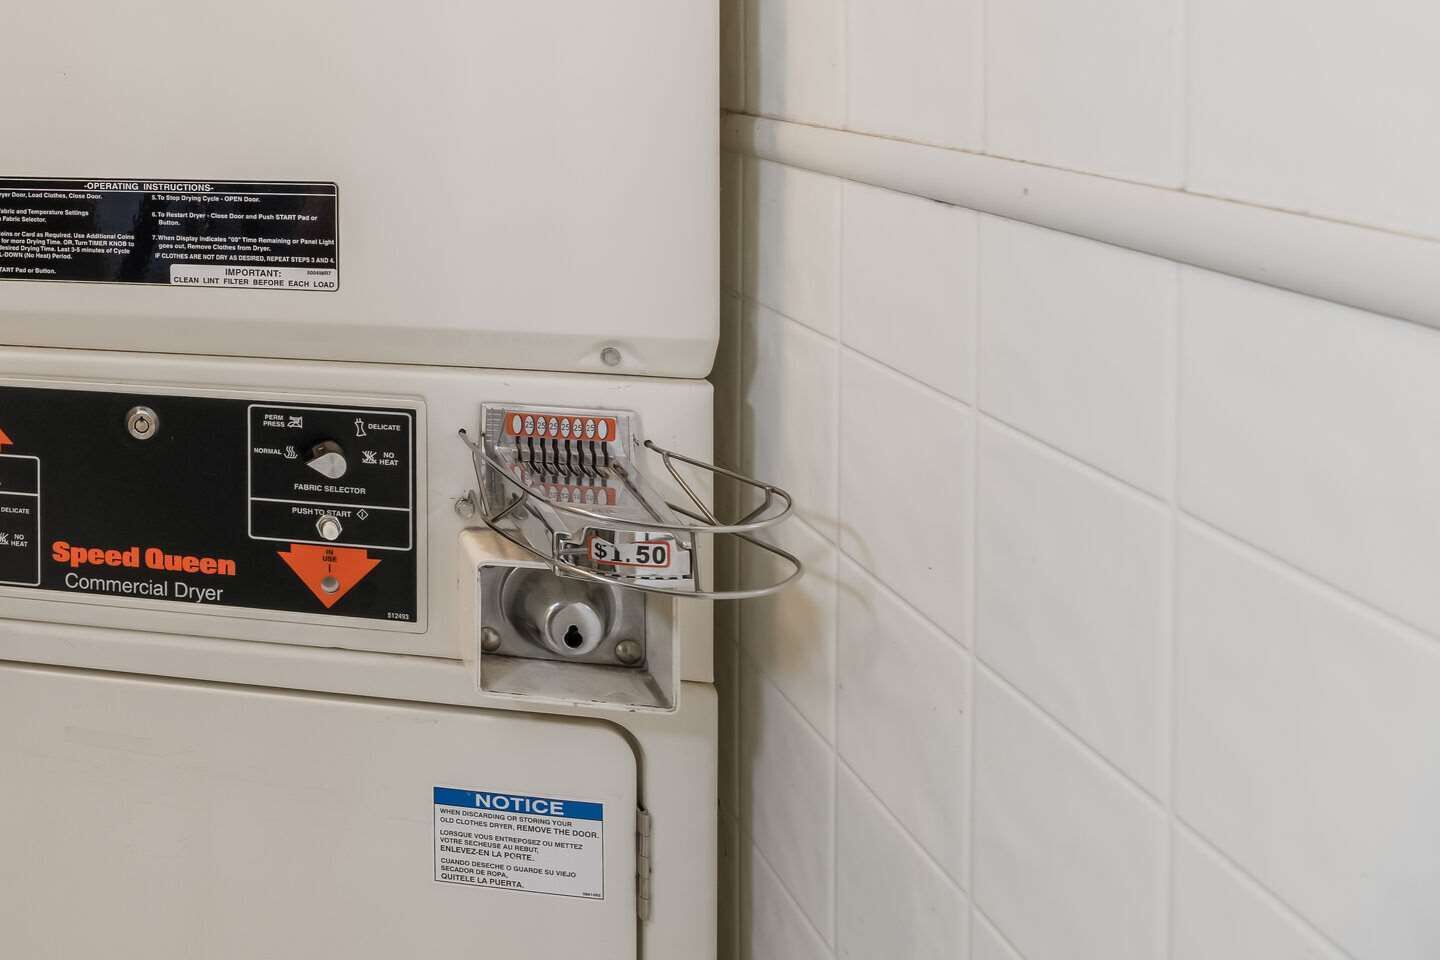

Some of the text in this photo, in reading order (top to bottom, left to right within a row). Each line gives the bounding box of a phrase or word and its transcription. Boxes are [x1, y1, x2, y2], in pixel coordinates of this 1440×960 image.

[84, 182, 214, 194] -OPERATING INSTRUCTIONS-
[252, 244, 271, 252] Dryer.
[224, 268, 282, 277] IMPORTANT:
[173, 276, 199, 284] CLEAN
[223, 277, 249, 285] FILTER
[252, 278, 284, 286] BEFORE
[263, 420, 285, 428] PRESS
[367, 423, 400, 431] DELICATE
[253, 447, 282, 455] NORMAL
[293, 483, 366, 494] FABRIC SELECTOR
[0, 506, 30, 514] DELICATE
[291, 506, 351, 518] PUSH TO START
[52, 541, 236, 576] Speed Queen
[64, 572, 224, 603] Commercial Dryer
[475, 794, 564, 815] NOTICE
[439, 808, 461, 816] WHEN
[461, 810, 506, 820] DISCARDING
[518, 816, 551, 825] STORING
[551, 819, 573, 827] YOUR
[455, 818, 488, 827] CLOTHES
[488, 821, 515, 831] DRYER,
[516, 824, 552, 834] REMOVE
[552, 827, 570, 836] THE
[572, 830, 600, 839] DOOR.
[439, 829, 472, 840] LORSQUE
[473, 833, 494, 841] VOUS
[494, 835, 541, 846] ENTREPOSEZ
[554, 841, 583, 850] METTEZ
[439, 836, 463, 845] VOTRE
[463, 839, 501, 849] SECHEUSE
[514, 844, 539, 854] REBUT,
[440, 844, 535, 861] ENLEVEZ-EN LA PORTE.
[440, 857, 470, 867] CUANDO
[471, 861, 505, 870] DESECHE
[512, 865, 543, 874] GUARDE
[555, 870, 576, 878] VIEJO
[440, 864, 509, 879] SECADOR DE ROPA,
[440, 873, 525, 888] QUITELE LA PUERTA.
